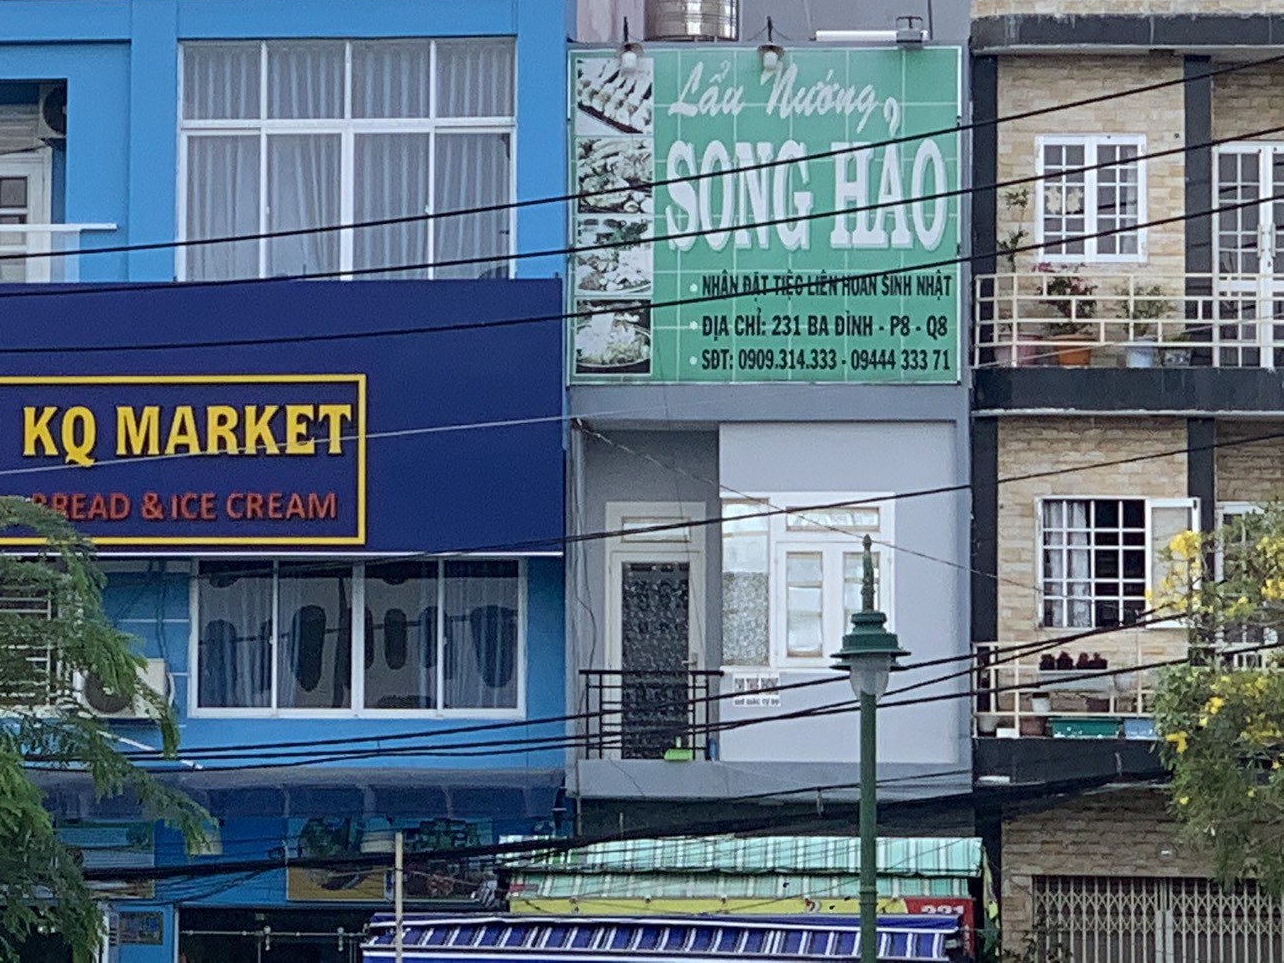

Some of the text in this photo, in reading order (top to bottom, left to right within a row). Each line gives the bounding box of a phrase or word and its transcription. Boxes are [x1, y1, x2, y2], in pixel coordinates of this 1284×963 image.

[667, 60, 746, 117] Lẩu
[665, 139, 814, 252] SONG
[881, 275, 912, 296] SINH
[917, 269, 952, 301] NHẬT
[702, 315, 729, 341] ĐỊA
[735, 307, 766, 336] CHỈ:
[772, 315, 801, 336] 231
[807, 315, 829, 336] BA
[835, 310, 873, 336] ĐÌNH
[890, 315, 910, 336] P8
[926, 315, 948, 340] Q8
[738, 348, 837, 370] 0909.314.333
[851, 348, 896, 370] 09444
[901, 348, 928, 370] 333
[933, 348, 950, 370] 71
[22, 404, 352, 467] KQ MARKET
[140, 492, 164, 520] &
[171, 493, 216, 520] ICE
[226, 493, 337, 520] CREAM
